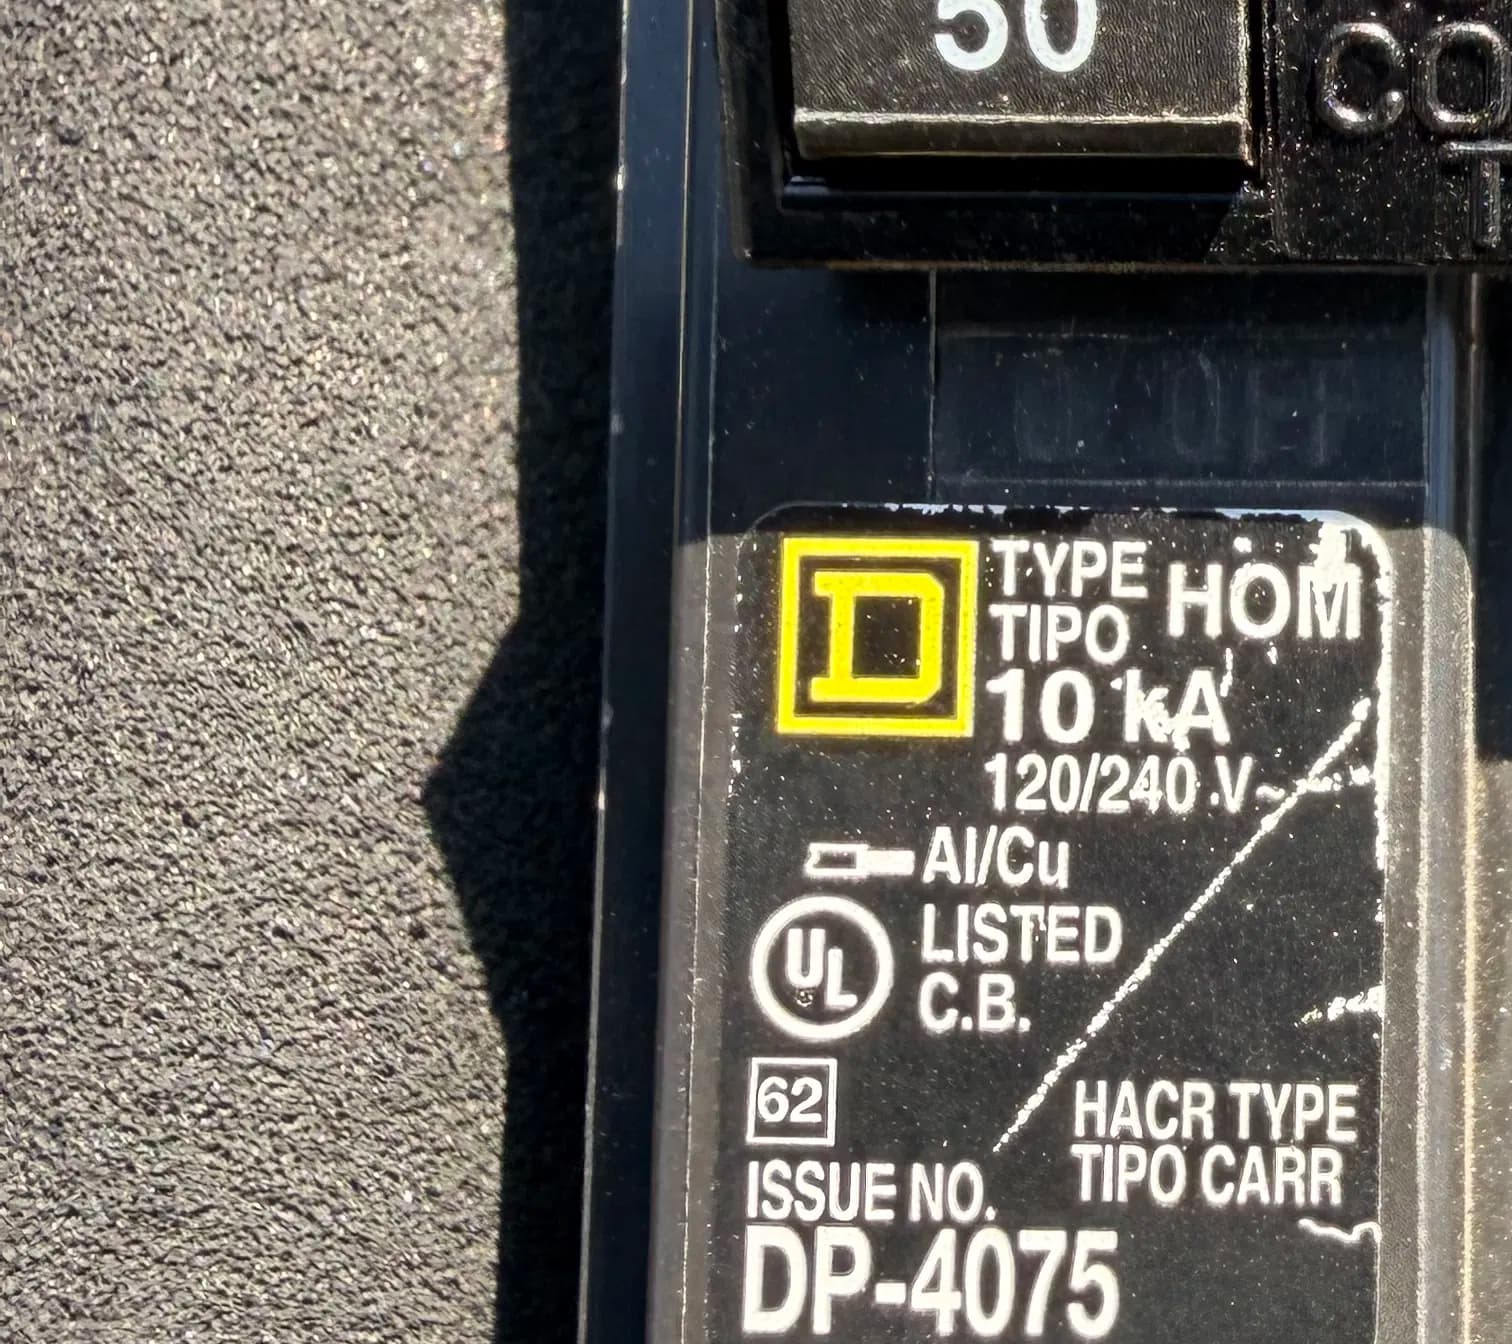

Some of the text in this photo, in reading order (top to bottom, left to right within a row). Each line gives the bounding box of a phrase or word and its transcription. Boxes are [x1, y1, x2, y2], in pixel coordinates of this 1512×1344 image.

[991, 537, 1149, 599] TYPE
[1167, 561, 1363, 641] HOM
[987, 603, 1132, 665] TIPO
[984, 667, 1232, 748] 10 kA
[983, 752, 1201, 815] 120/240
[919, 902, 1122, 965] LISTED
[917, 969, 1033, 1034] C.B.
[756, 1076, 824, 1124] 62
[1073, 1079, 1359, 1143] HACR TYPE
[746, 1159, 998, 1223] ISSUE NO.
[1069, 1141, 1343, 1205] TIPO CARR
[740, 1224, 1121, 1340] DP-4075
